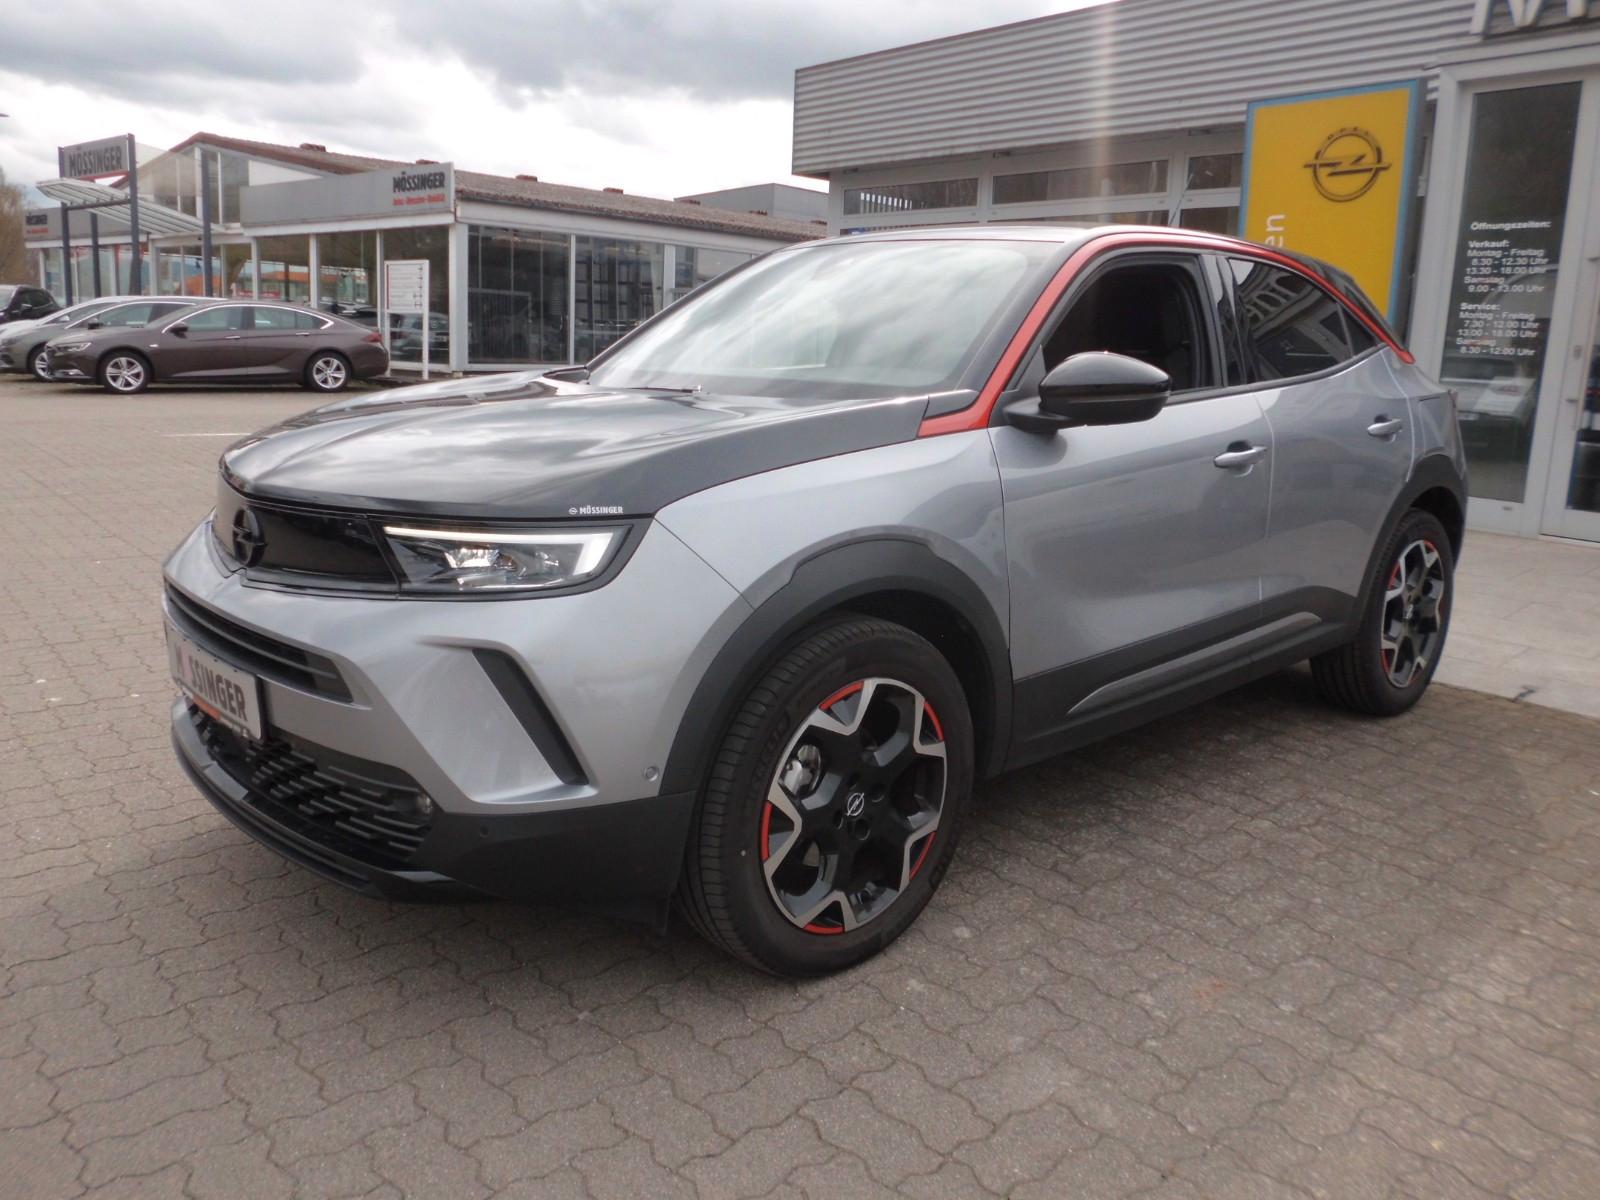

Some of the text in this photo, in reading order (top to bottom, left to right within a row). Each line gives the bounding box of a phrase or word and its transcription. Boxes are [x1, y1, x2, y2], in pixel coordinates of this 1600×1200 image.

[393, 171, 445, 193] MÖSSINGER
[579, 505, 624, 515] MÖSSINGER
[174, 642, 249, 722] MSSINGER
